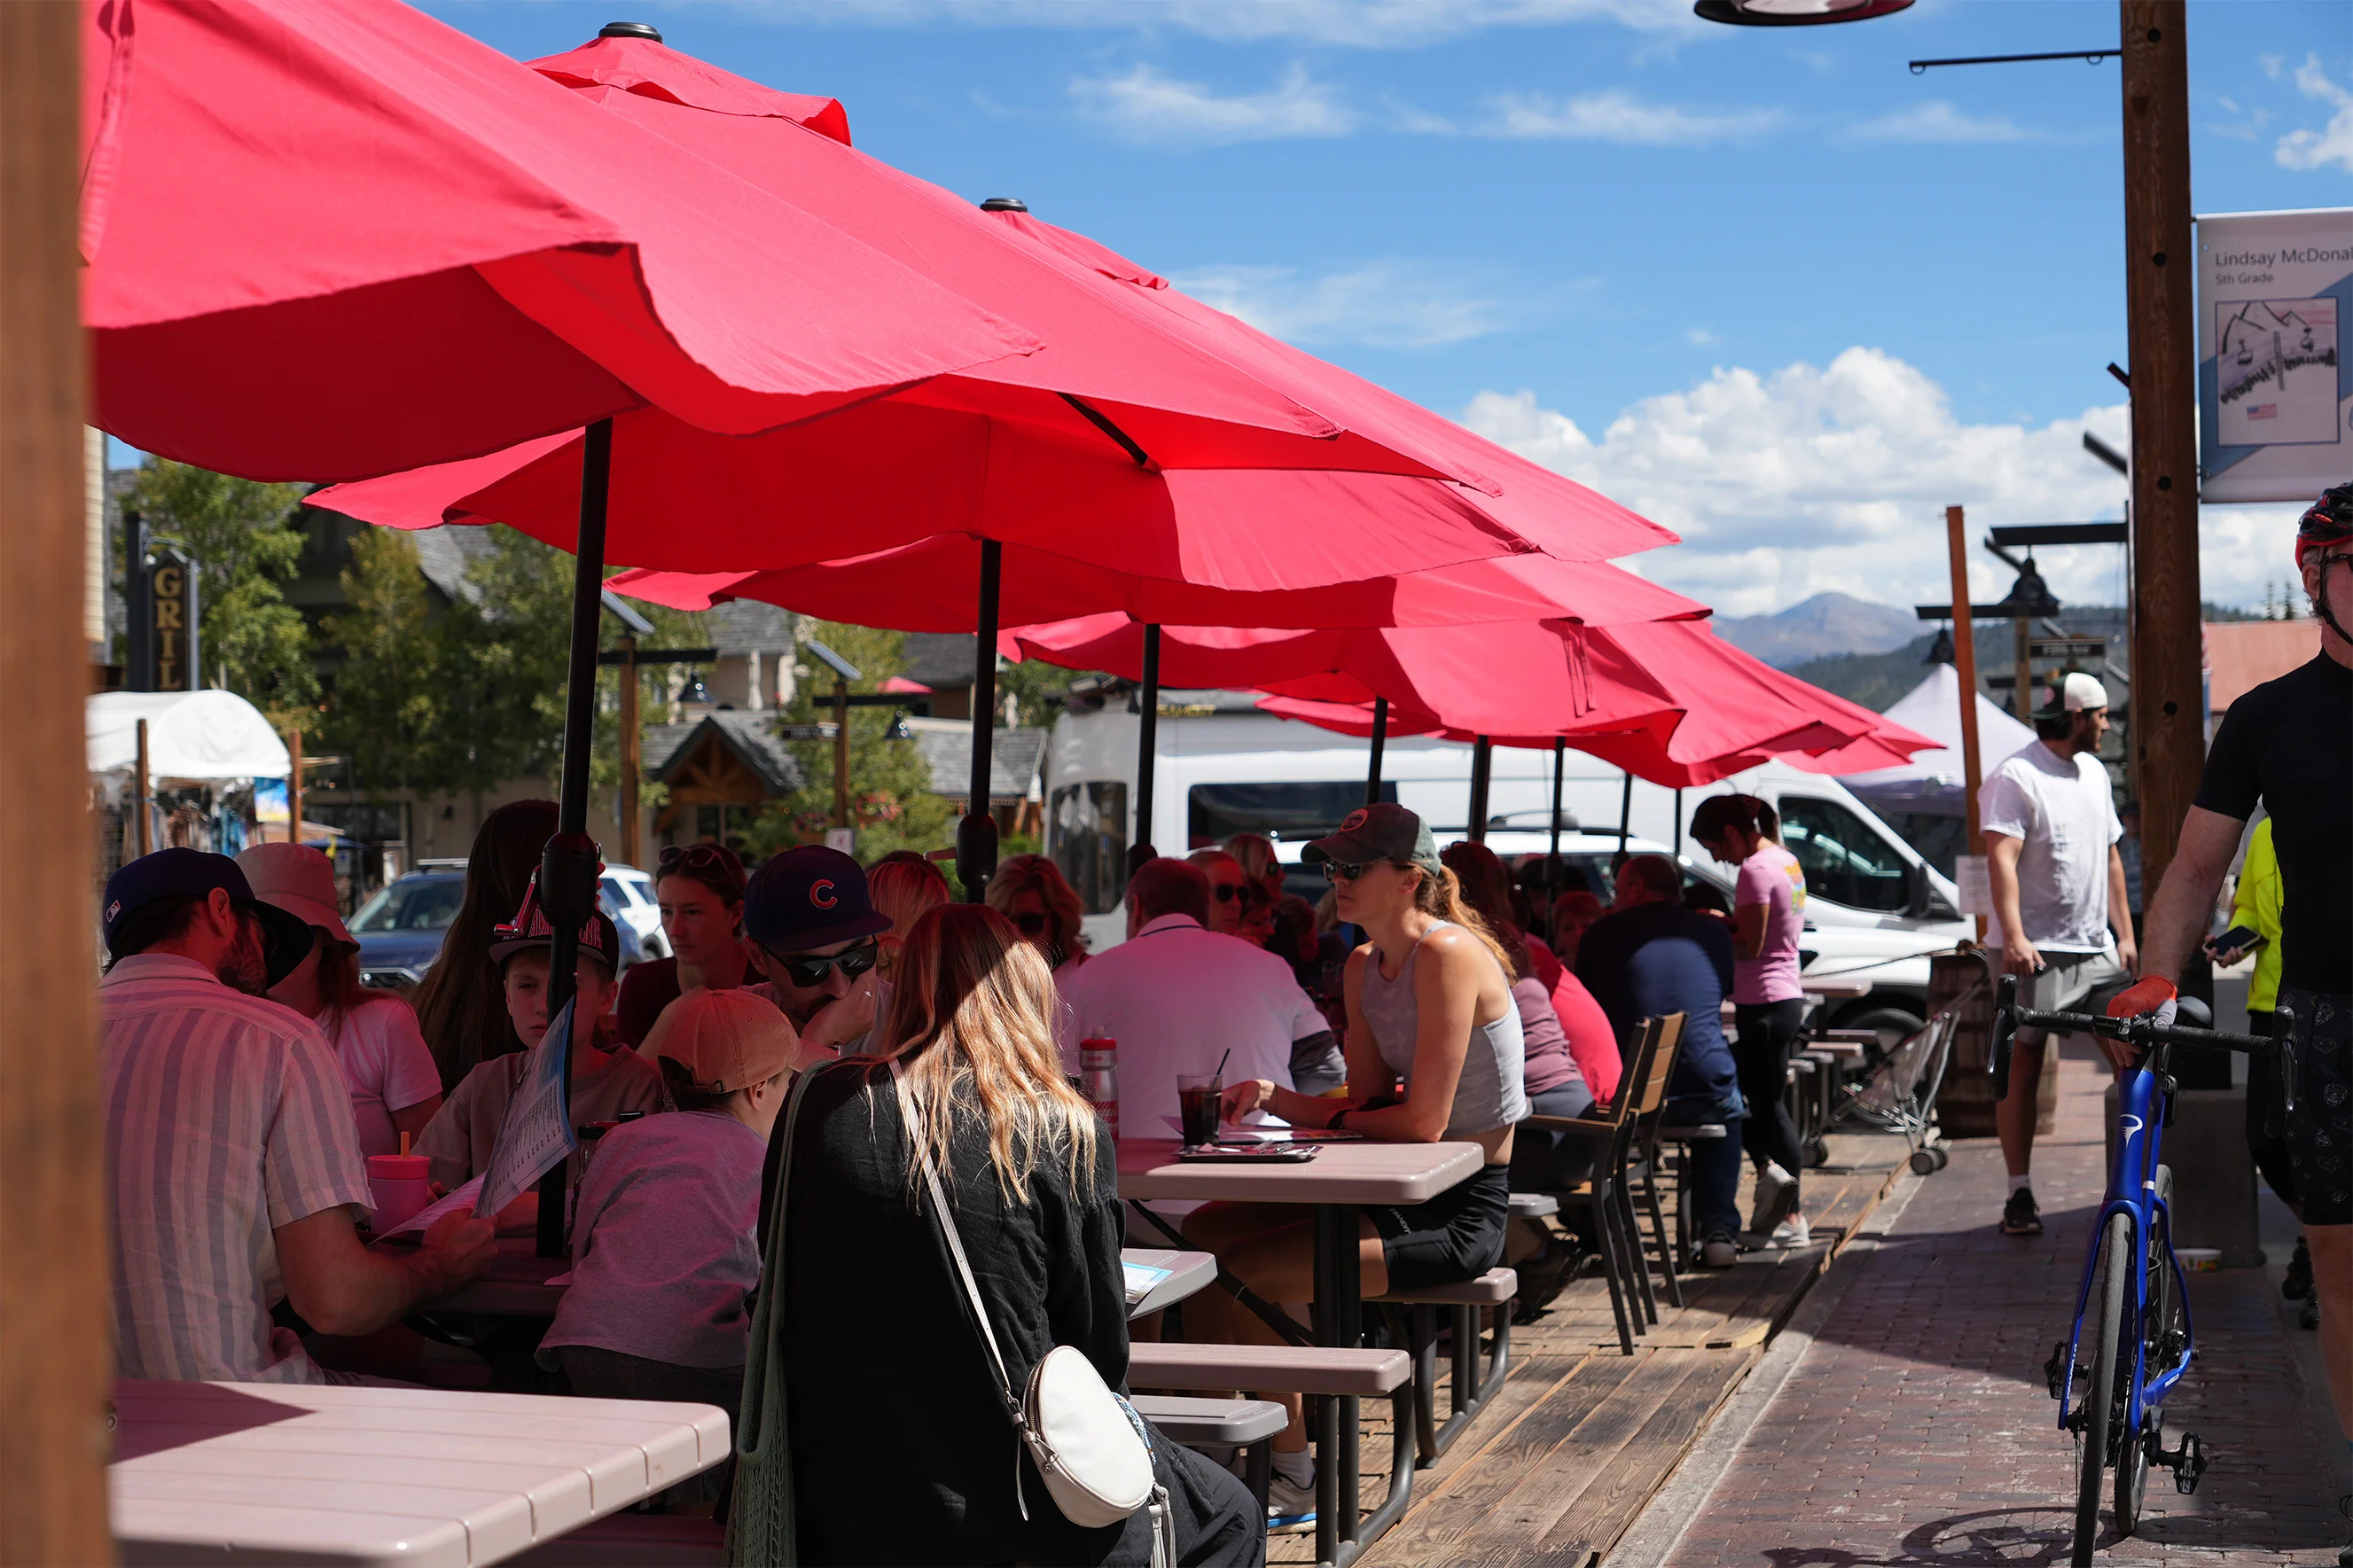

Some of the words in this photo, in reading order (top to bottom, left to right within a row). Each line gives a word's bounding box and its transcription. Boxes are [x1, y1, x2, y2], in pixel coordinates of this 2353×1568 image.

[2216, 249, 2276, 269] Lindsay
[2216, 273, 2235, 285] 5th
[2239, 272, 2274, 285] Grade
[809, 878, 838, 910] C
